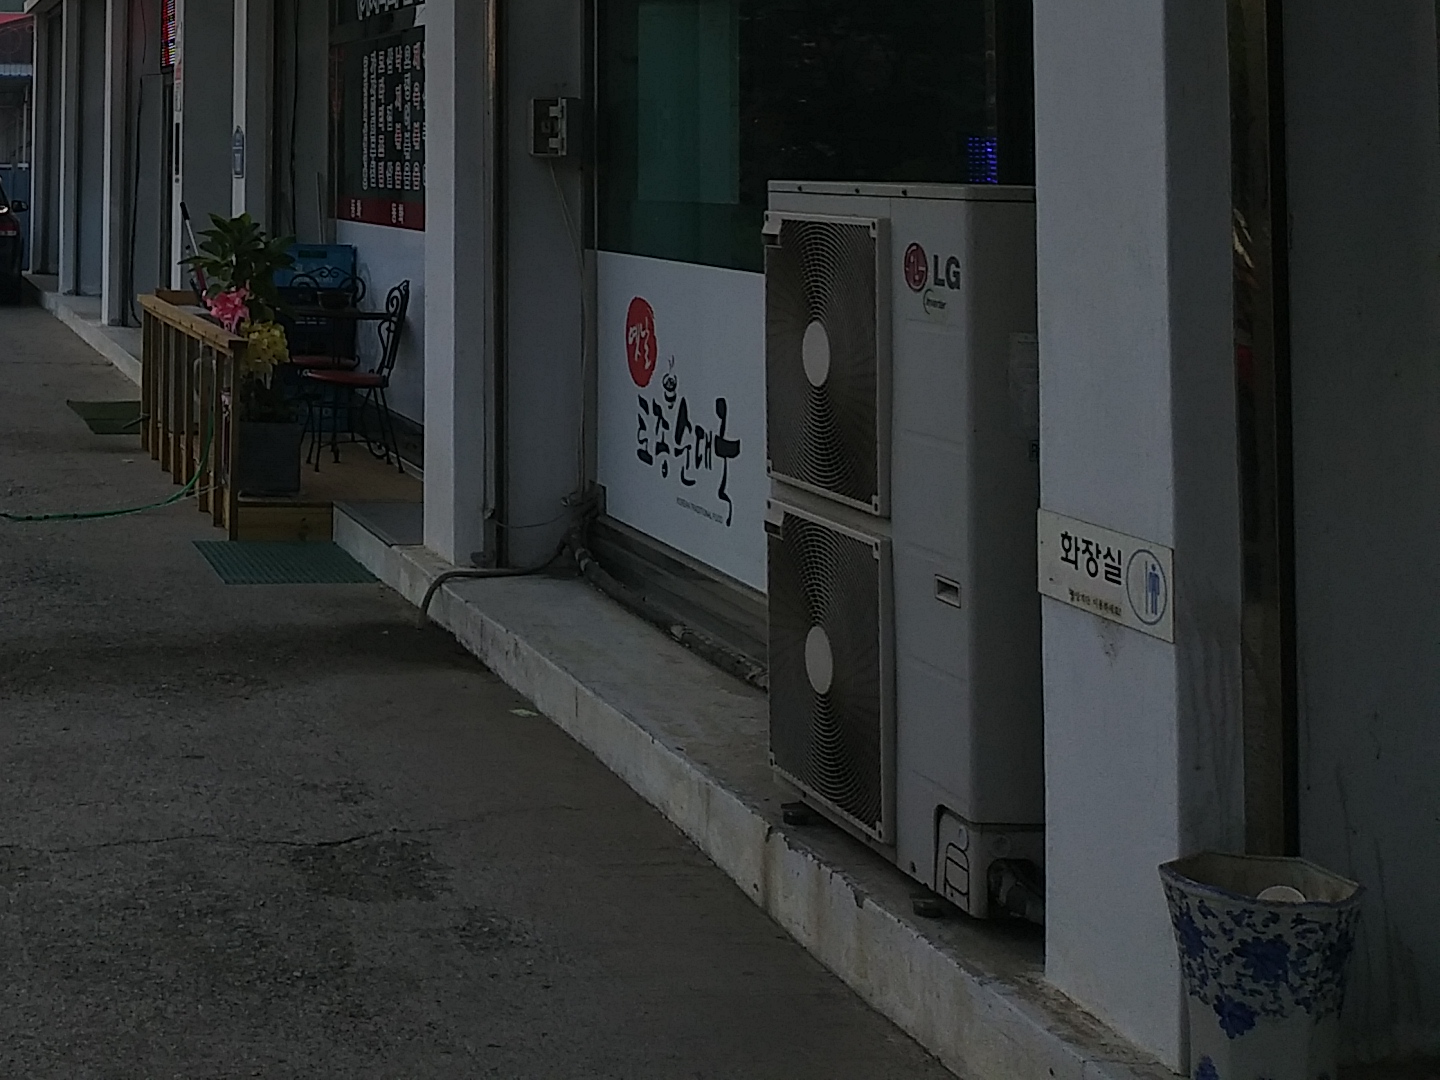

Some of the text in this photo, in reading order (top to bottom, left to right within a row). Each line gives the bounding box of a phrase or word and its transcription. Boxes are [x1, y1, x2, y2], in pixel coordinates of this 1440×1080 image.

[933, 254, 961, 290] LG
[628, 316, 651, 370] 옛날
[1060, 530, 1122, 586] 화장실
